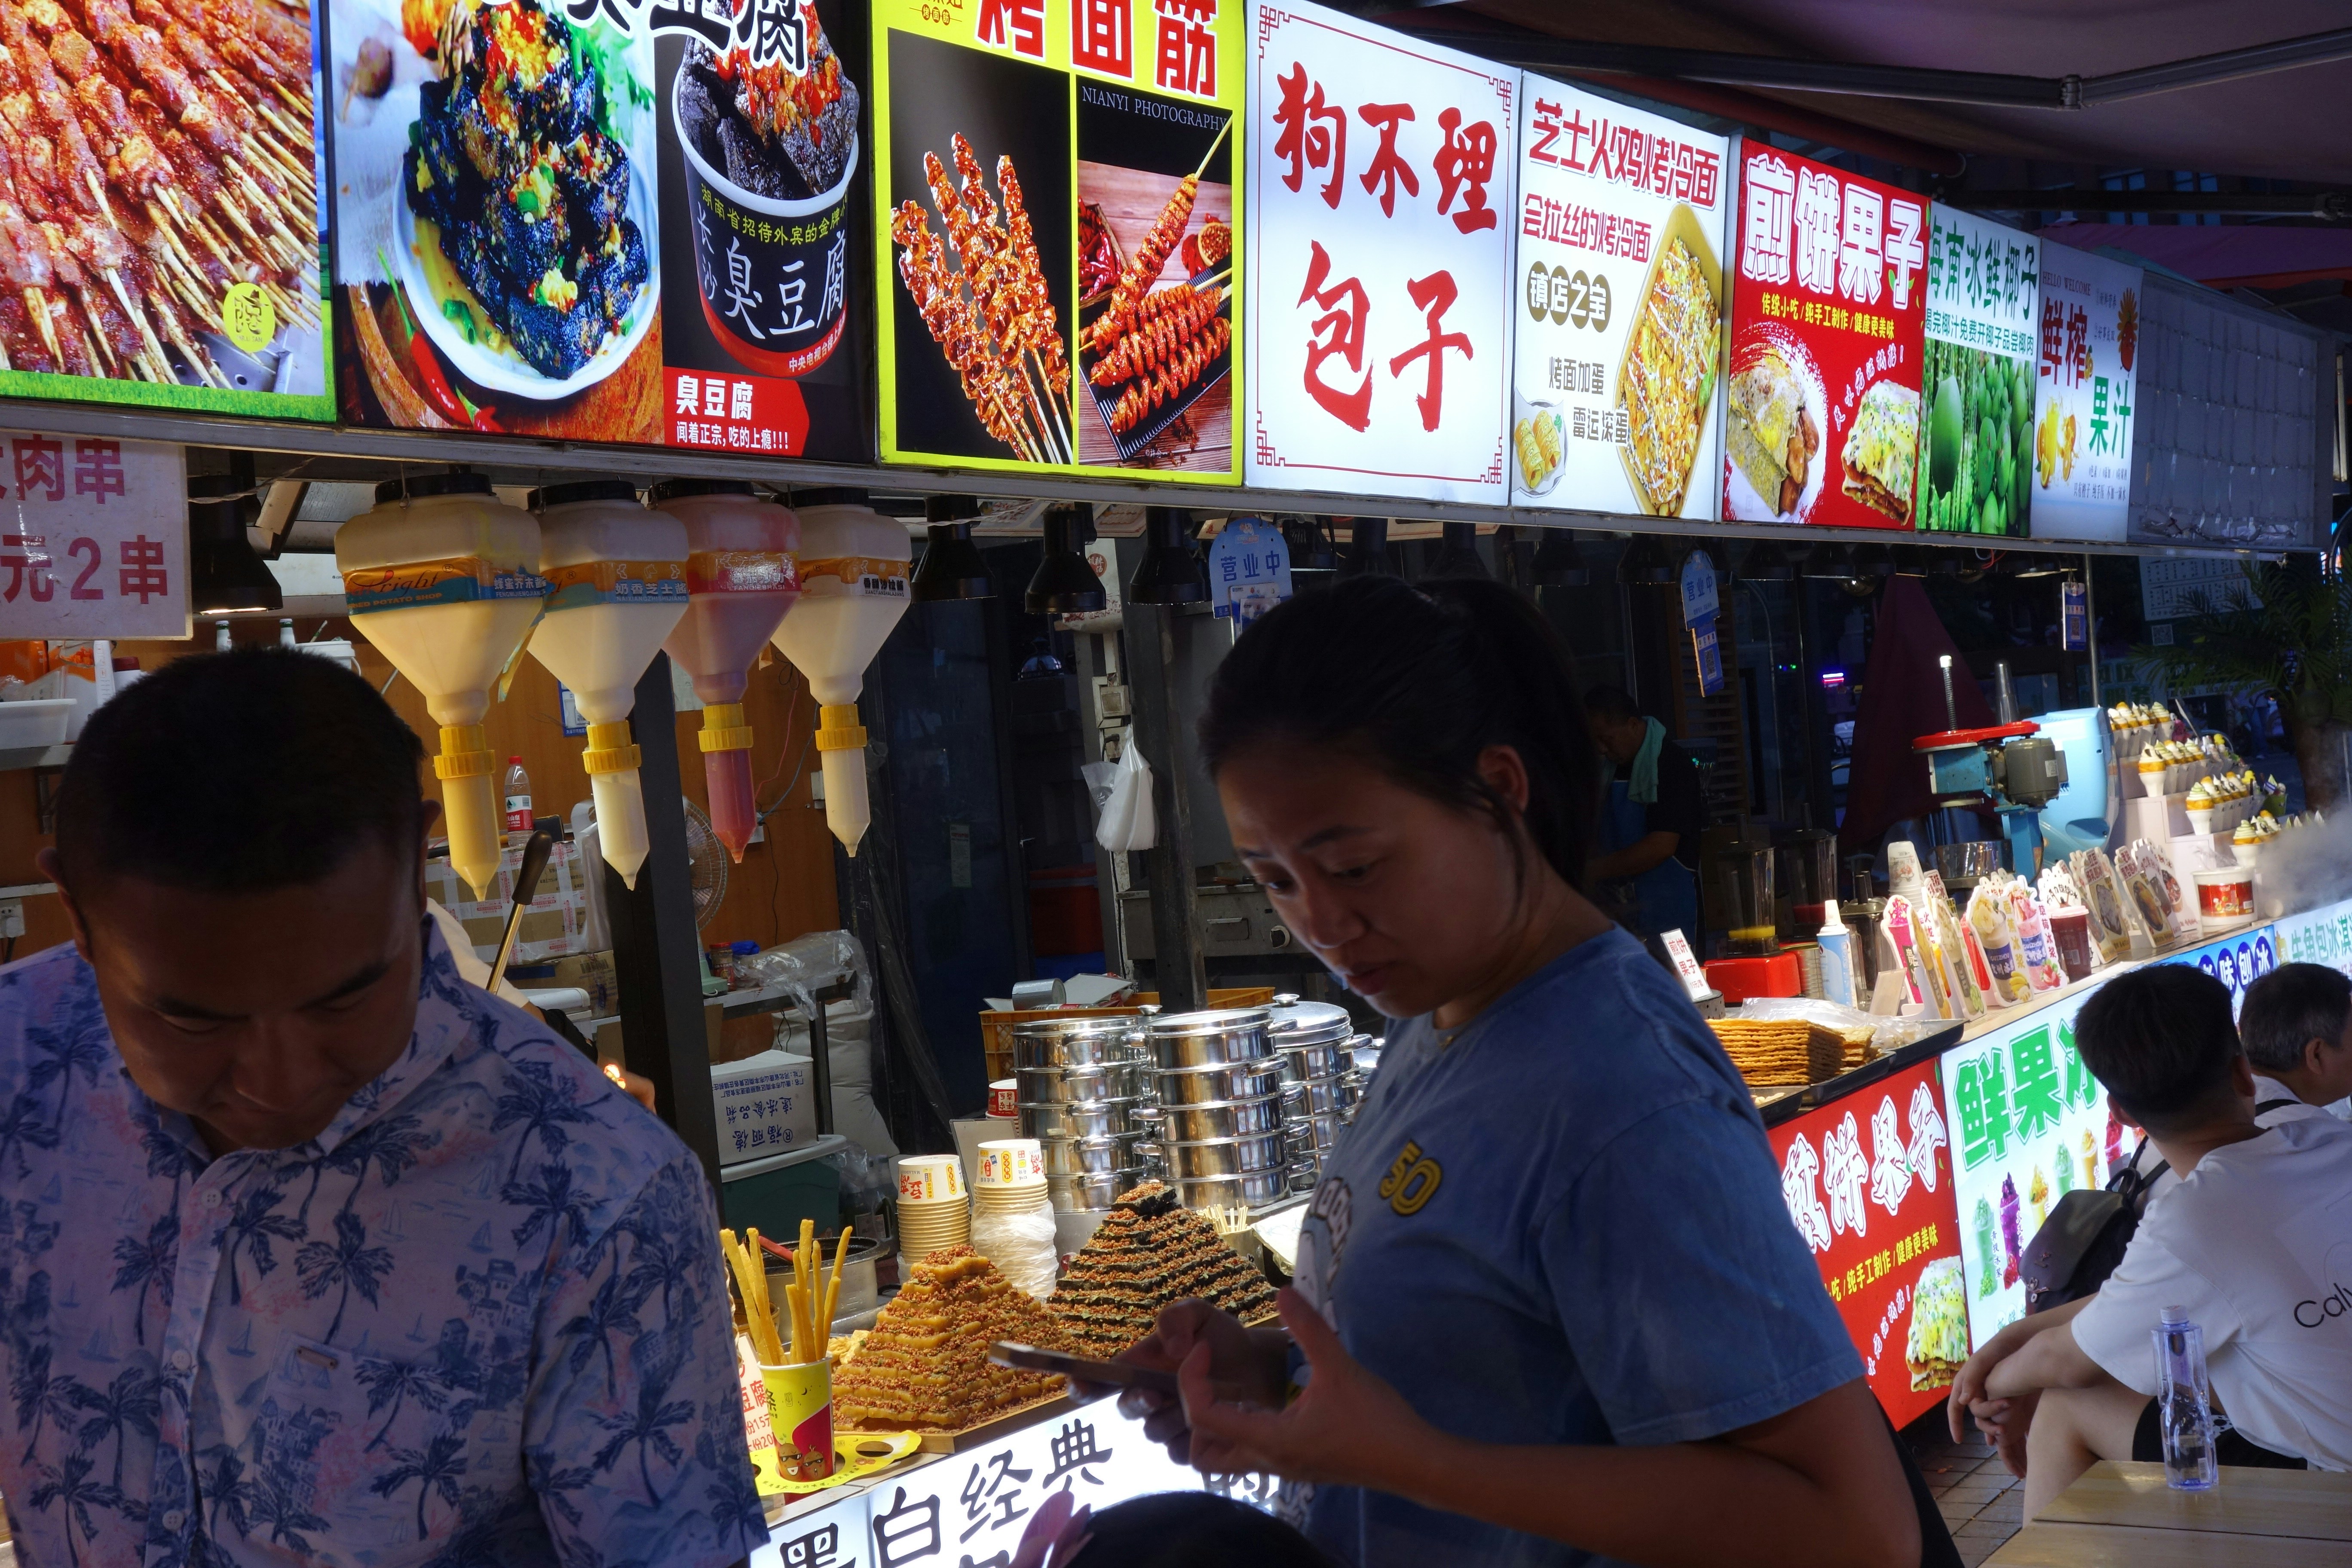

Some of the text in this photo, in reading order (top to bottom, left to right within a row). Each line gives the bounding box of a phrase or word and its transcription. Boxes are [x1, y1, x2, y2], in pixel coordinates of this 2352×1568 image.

[923, 6, 949, 23] 烤面筋
[1081, 86, 1227, 130] NIANYI PHOTOGRAPHY
[1272, 61, 1498, 235] 狗不理
[1529, 97, 1720, 208] 芝士火鸡烤冷面
[697, 201, 717, 300] 长沙
[1523, 193, 1652, 263] 会拉丝的烤冷面
[1742, 153, 1924, 309] 煎饼果子
[725, 229, 846, 339] 臭豆腐
[1927, 214, 2038, 321] 海南冰鲜椰子
[2043, 271, 2091, 296] HELLO WELCOME
[1530, 270, 1607, 321] 镇店之宝
[1296, 239, 1473, 433] 包子
[2040, 296, 2088, 390] 鲜榨
[676, 375, 753, 421] 臭豆腐
[1549, 356, 1605, 395] 烤面加蛋
[2089, 375, 2132, 459] 果汁
[0, 434, 125, 504] 肉串
[616, 582, 686, 595] 奶香芝士酱
[1220, 550, 1280, 582] 营业中
[1686, 573, 1713, 602] 营业中
[373, 596, 412, 606] POTATO
[416, 592, 442, 601] SHOP
[1668, 937, 1688, 957] 煎饼
[2038, 904, 2057, 959] 草莓冰浆
[2291, 911, 2352, 963] 牛角包冰淇
[1678, 958, 1696, 977] 果子
[1990, 952, 2009, 962] GUIZHOU
[726, 1096, 792, 1124] 速冻食品箱
[999, 1102, 1014, 1110] 平安
[732, 1124, 782, 1152] 福丽德
[900, 1174, 923, 1200] 豆腐
[1782, 1082, 1946, 1254] 煎饼果子
